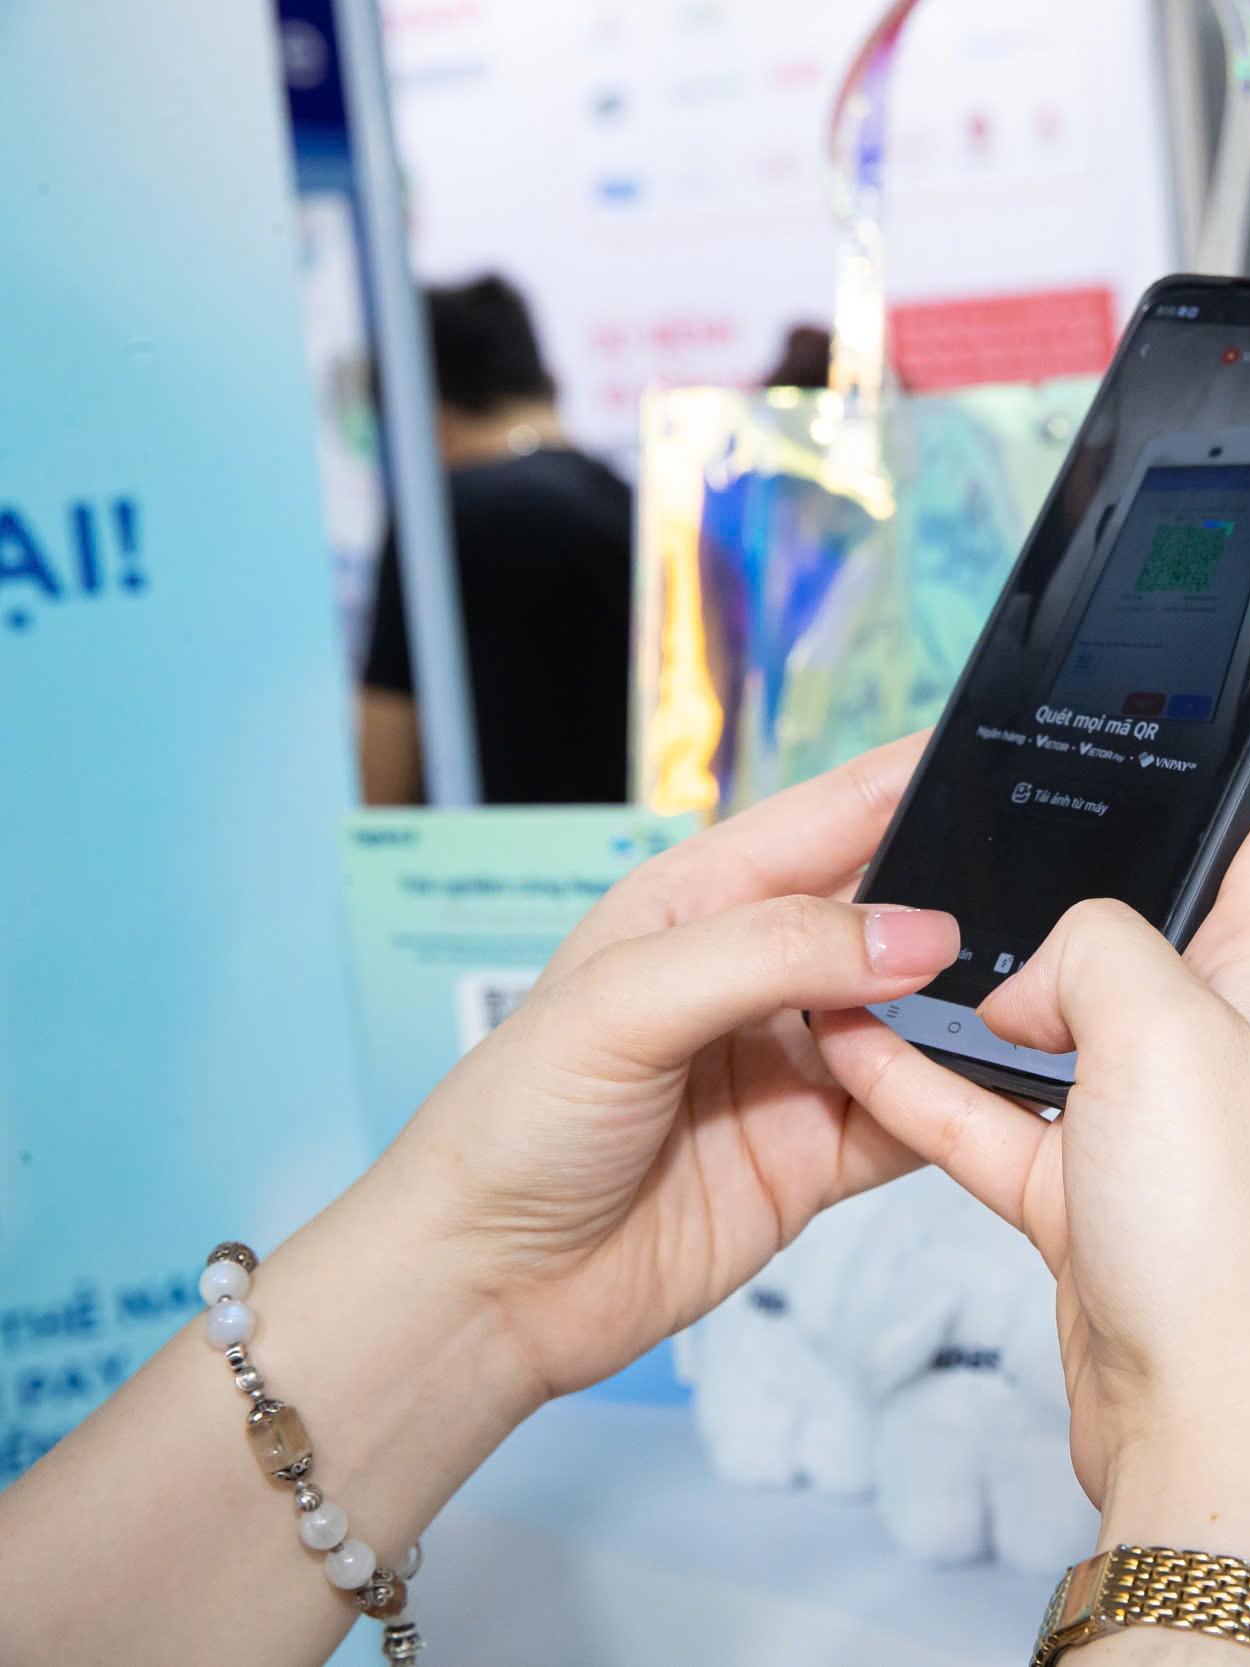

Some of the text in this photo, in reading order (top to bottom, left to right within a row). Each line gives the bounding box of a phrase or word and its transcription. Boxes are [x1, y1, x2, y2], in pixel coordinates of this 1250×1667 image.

[1035, 704, 1160, 740] Quét mọi mã QR
[1034, 789, 1109, 817] Tải ảnh từ máy
